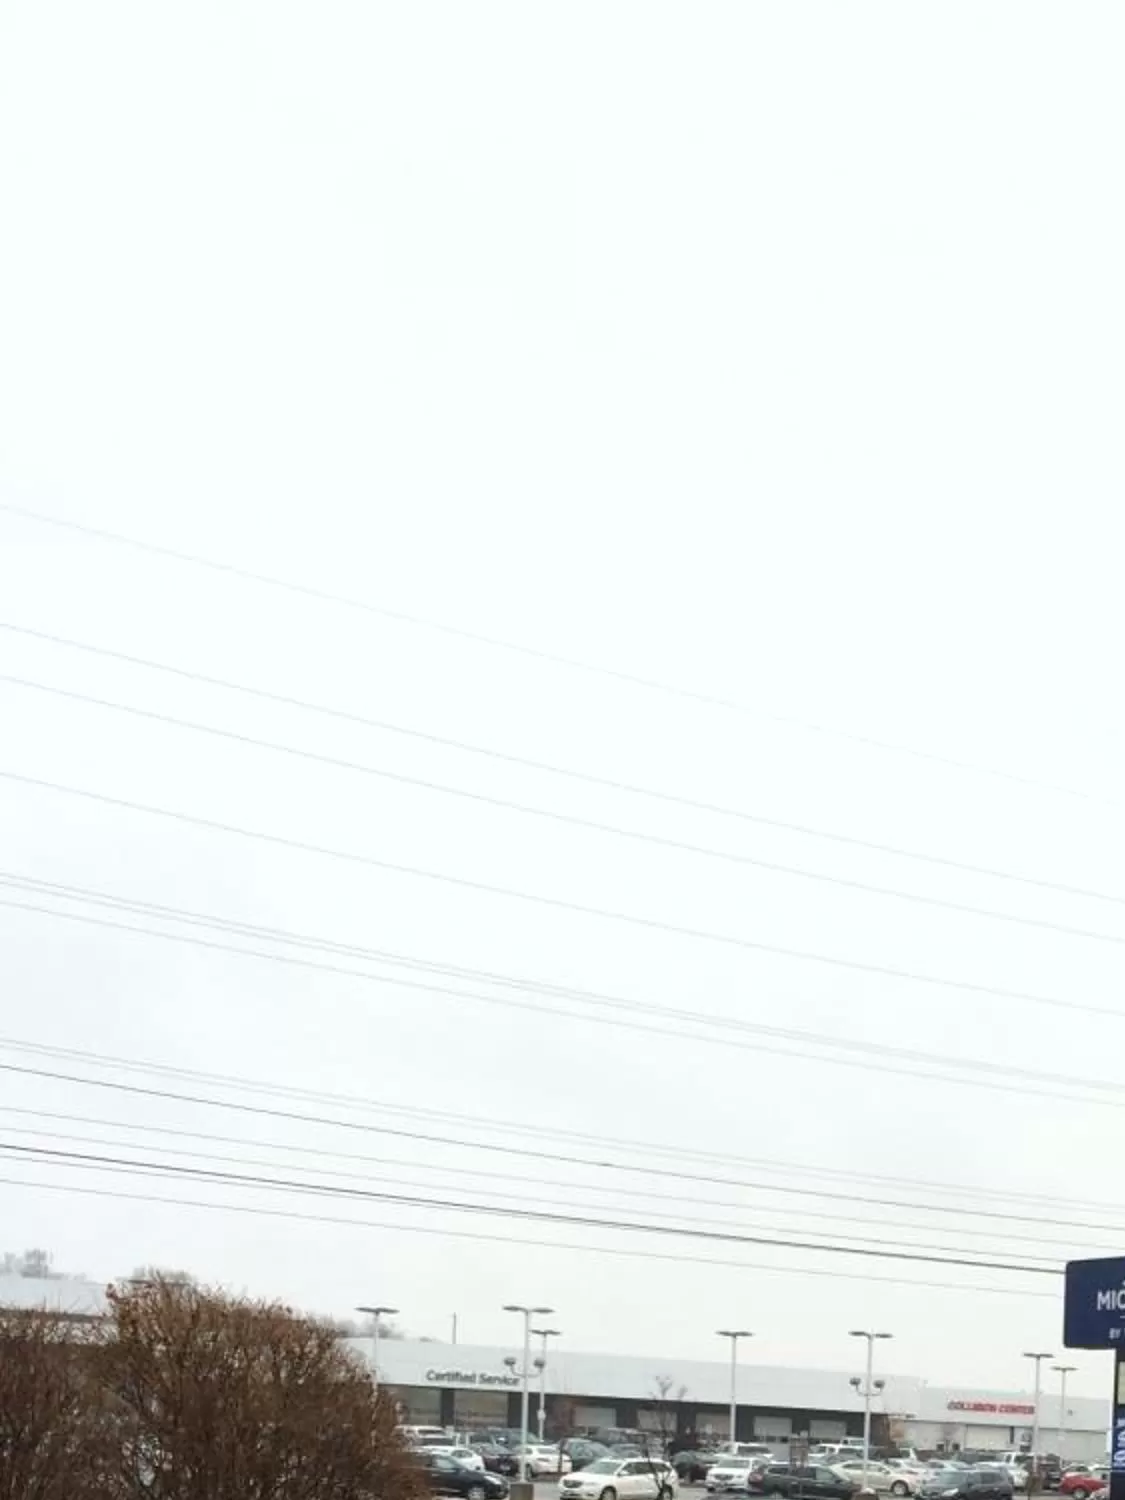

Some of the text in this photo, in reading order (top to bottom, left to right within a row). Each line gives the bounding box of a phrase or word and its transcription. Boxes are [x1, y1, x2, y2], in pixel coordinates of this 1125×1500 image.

[1108, 1327, 1121, 1340] BY
[426, 1369, 520, 1386] Certified Service
